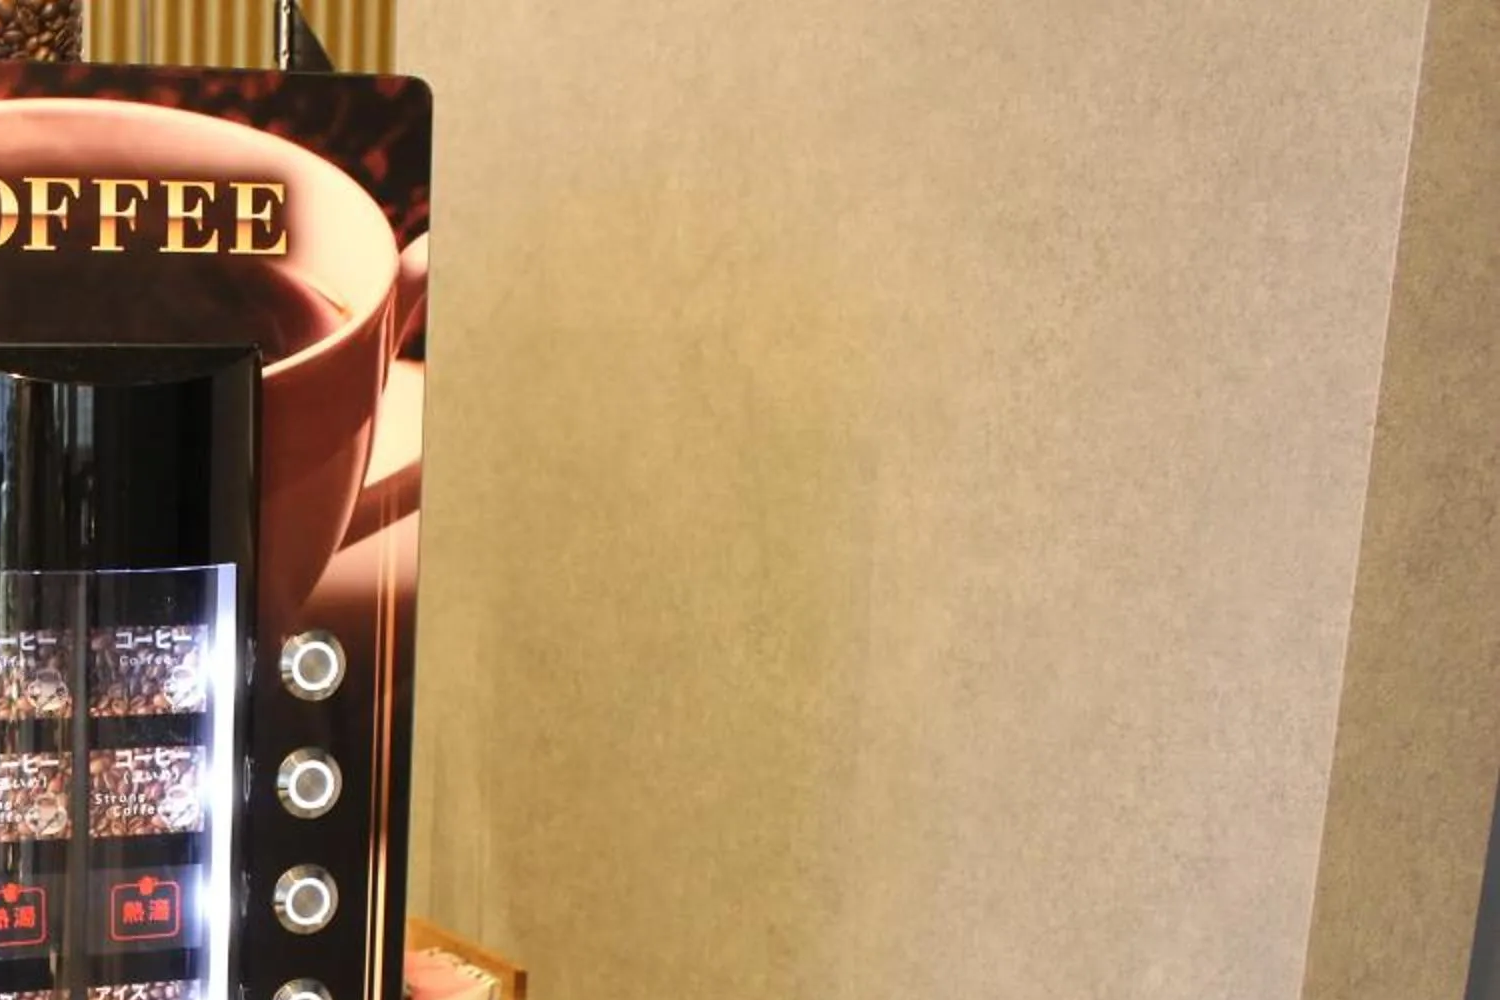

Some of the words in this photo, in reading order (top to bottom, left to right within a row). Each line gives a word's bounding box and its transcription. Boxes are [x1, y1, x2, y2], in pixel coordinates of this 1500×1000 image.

[115, 629, 192, 650] コーヒー
[115, 747, 190, 769] コーヒー
